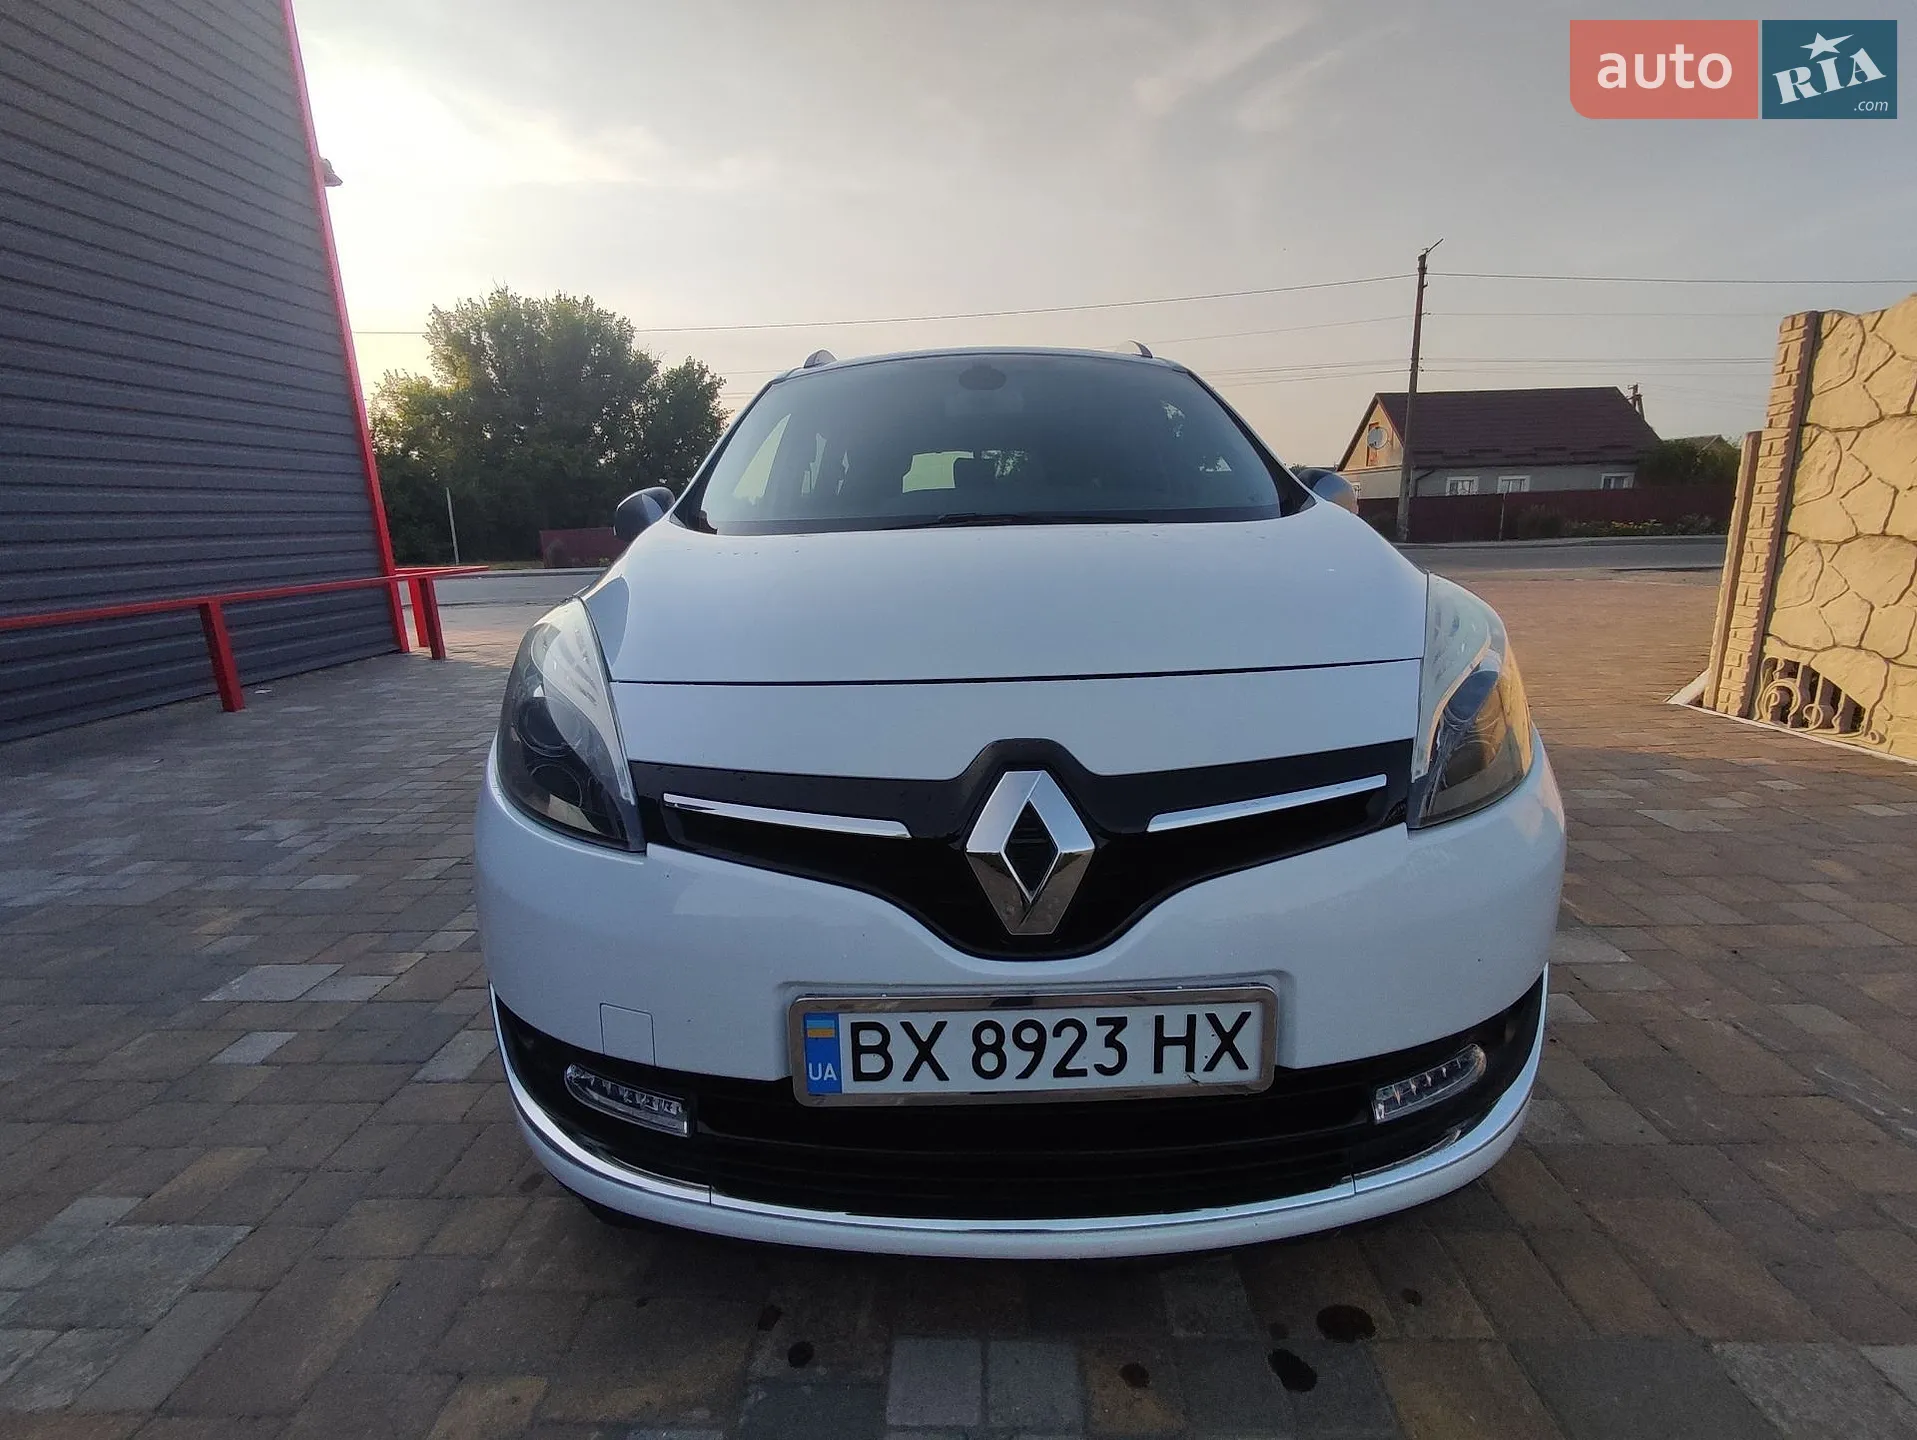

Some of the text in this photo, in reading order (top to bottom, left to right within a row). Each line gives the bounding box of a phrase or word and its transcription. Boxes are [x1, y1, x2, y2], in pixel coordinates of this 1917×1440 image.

[850, 1011, 1252, 1082] BX 8923 HX
[808, 1062, 838, 1081] UA
